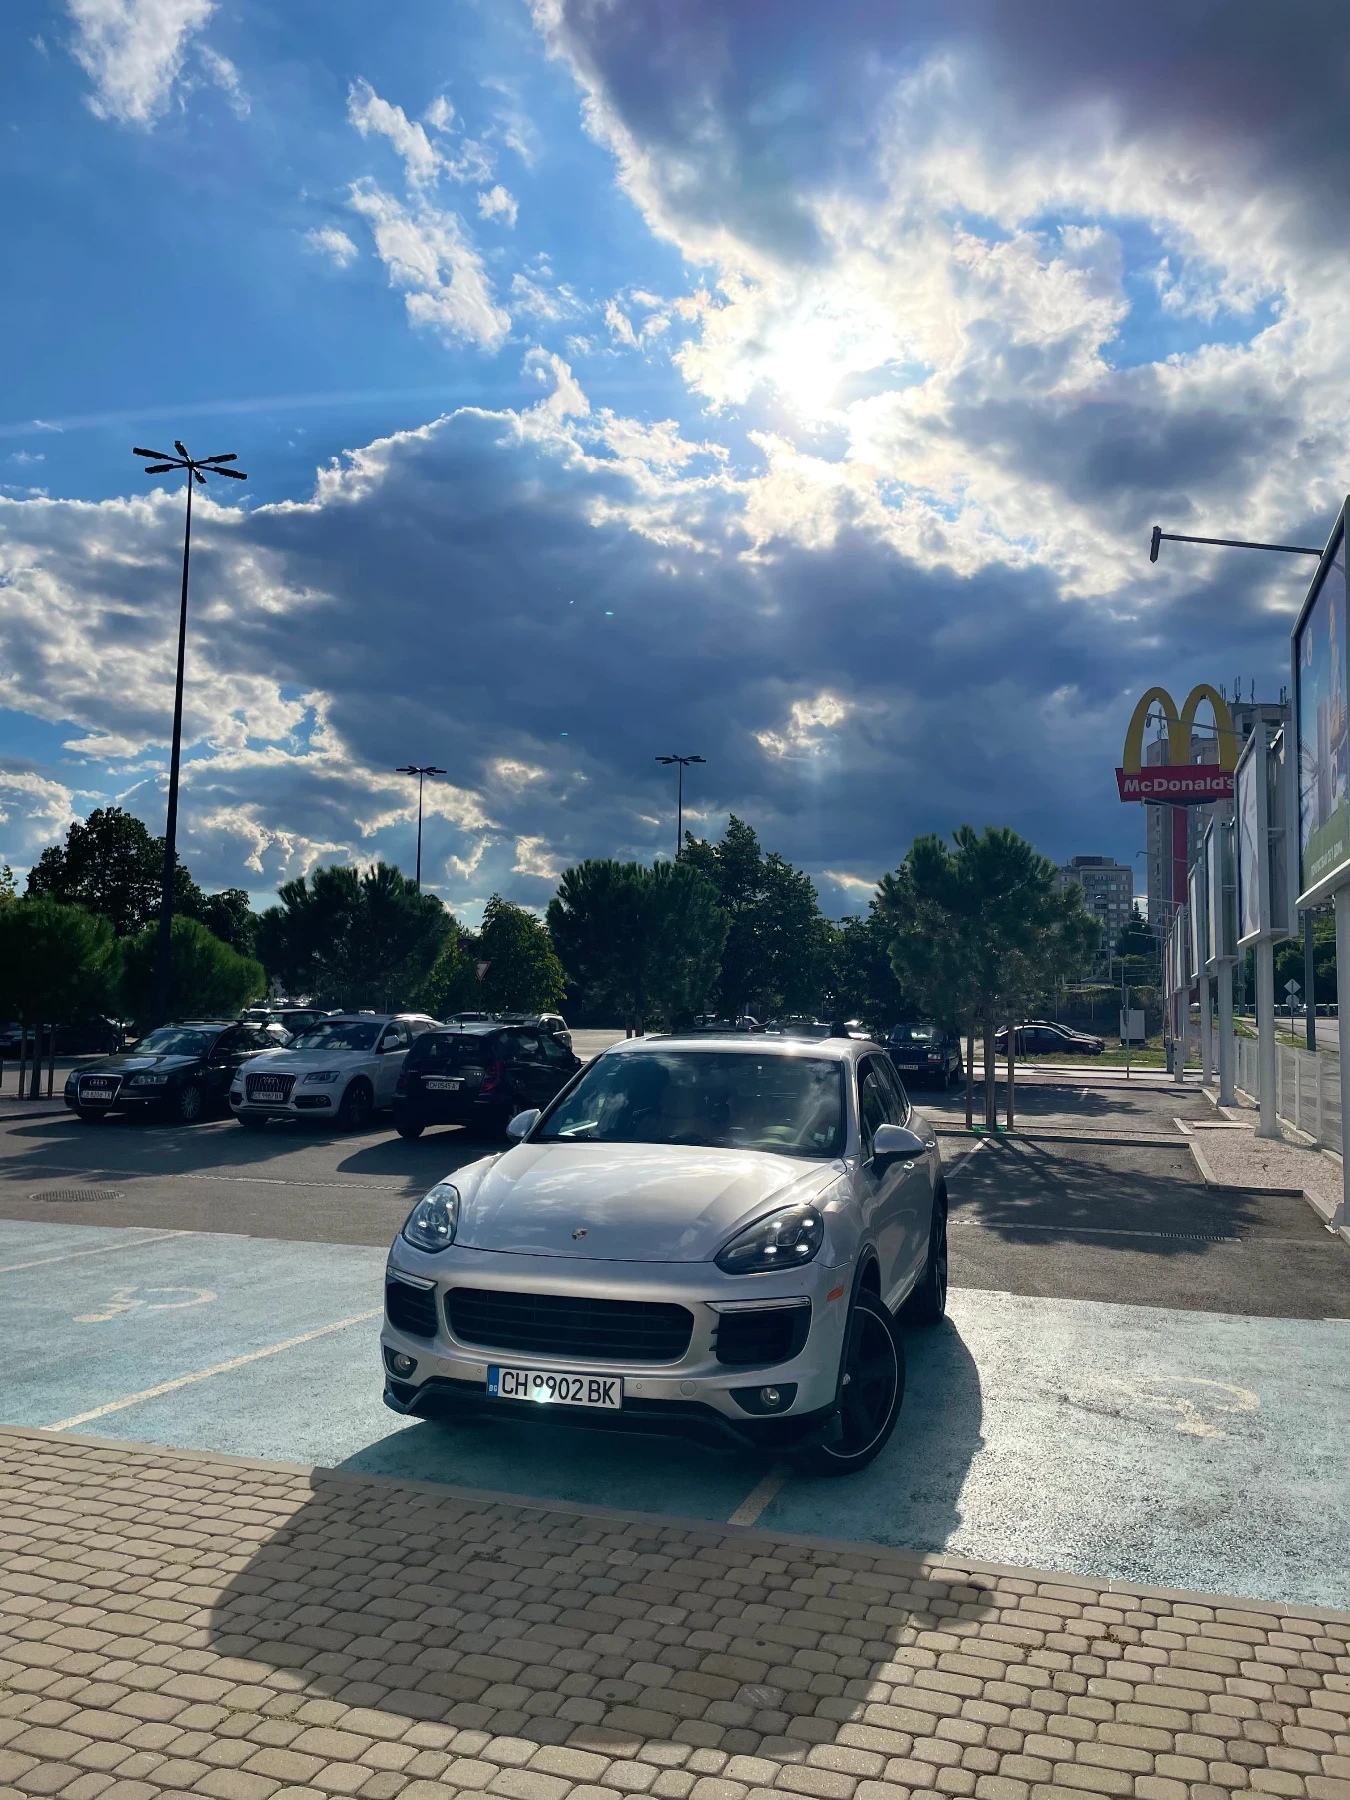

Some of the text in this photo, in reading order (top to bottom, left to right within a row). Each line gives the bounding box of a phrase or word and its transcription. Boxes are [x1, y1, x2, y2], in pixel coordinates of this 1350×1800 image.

[1124, 777, 1234, 792] McDonald's
[502, 1372, 616, 1405] CH 9902 BK
